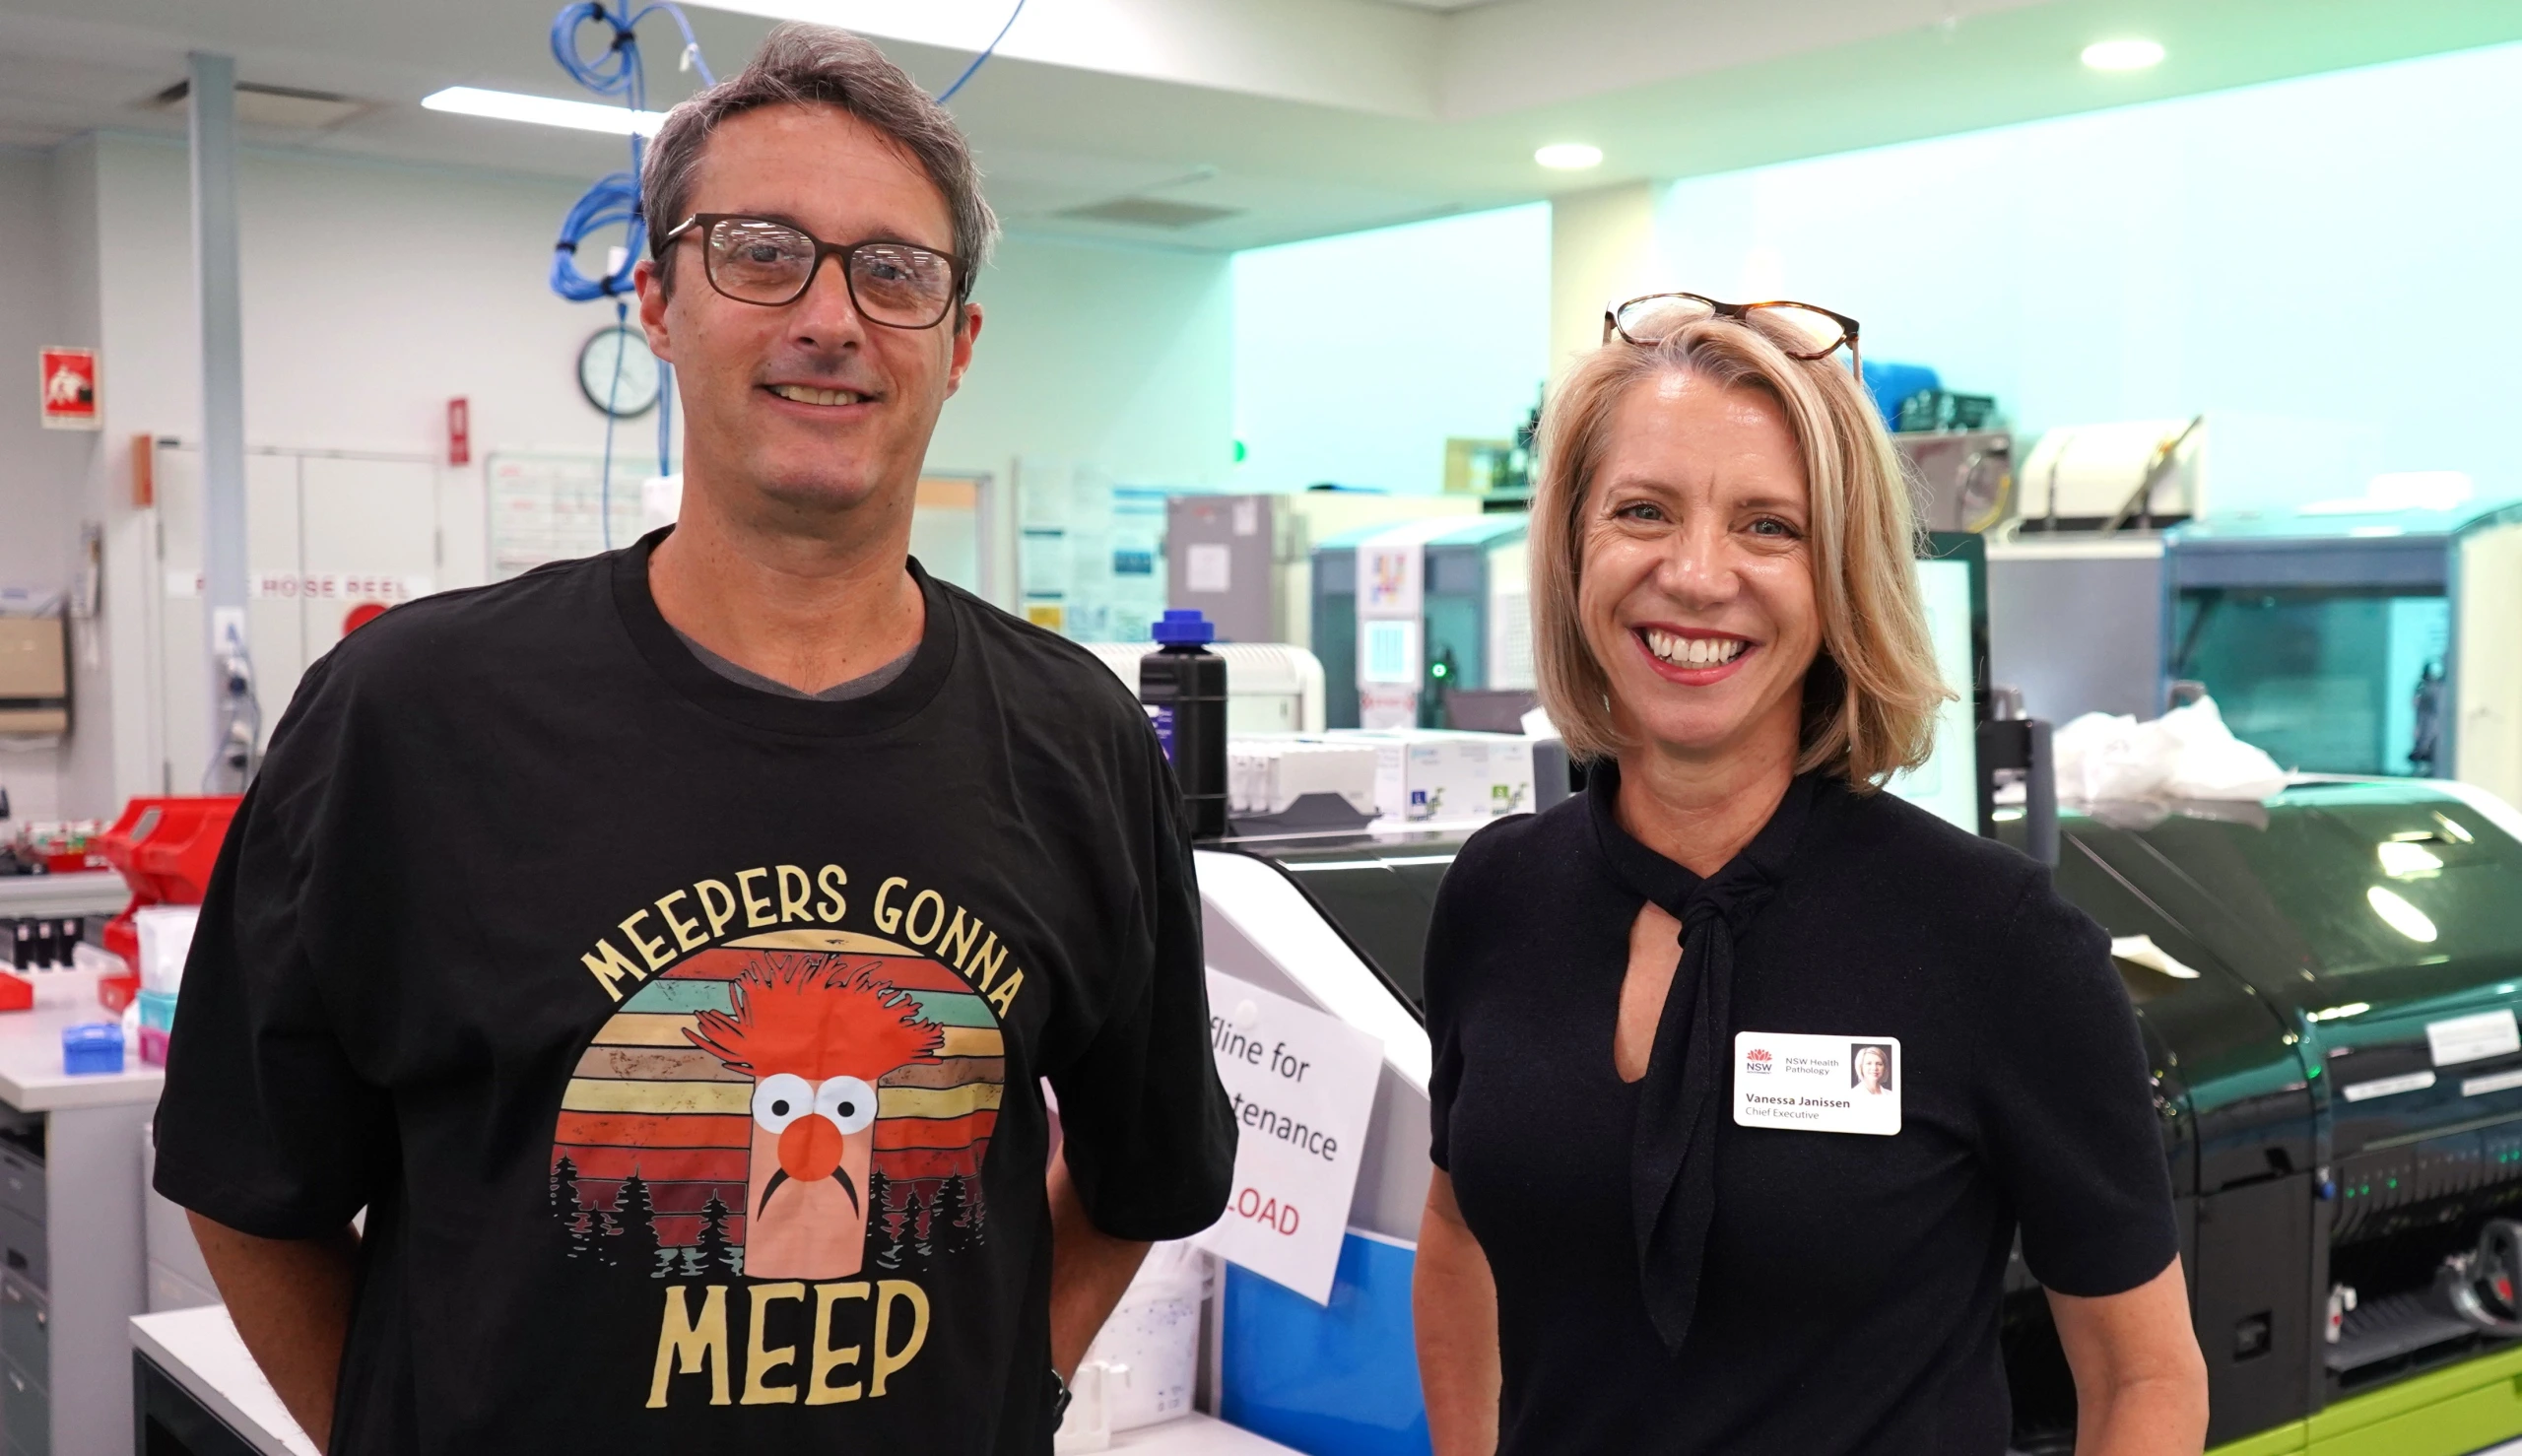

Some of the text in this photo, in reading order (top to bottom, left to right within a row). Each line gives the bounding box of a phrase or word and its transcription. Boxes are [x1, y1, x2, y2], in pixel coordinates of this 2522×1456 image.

[261, 574, 335, 598] HOSE
[581, 865, 1024, 1019] MEEPERS GONNA
[1271, 1041, 1310, 1083] for
[1747, 1062, 1772, 1071] NSW
[1785, 1065, 1830, 1076] Pathology
[1745, 1106, 1820, 1119] Chief Executive
[1746, 1092, 1851, 1108] Vanessa Janissen
[1233, 1092, 1338, 1161] tenance
[1228, 1187, 1299, 1236] OAD
[646, 1281, 929, 1408] MEEP
